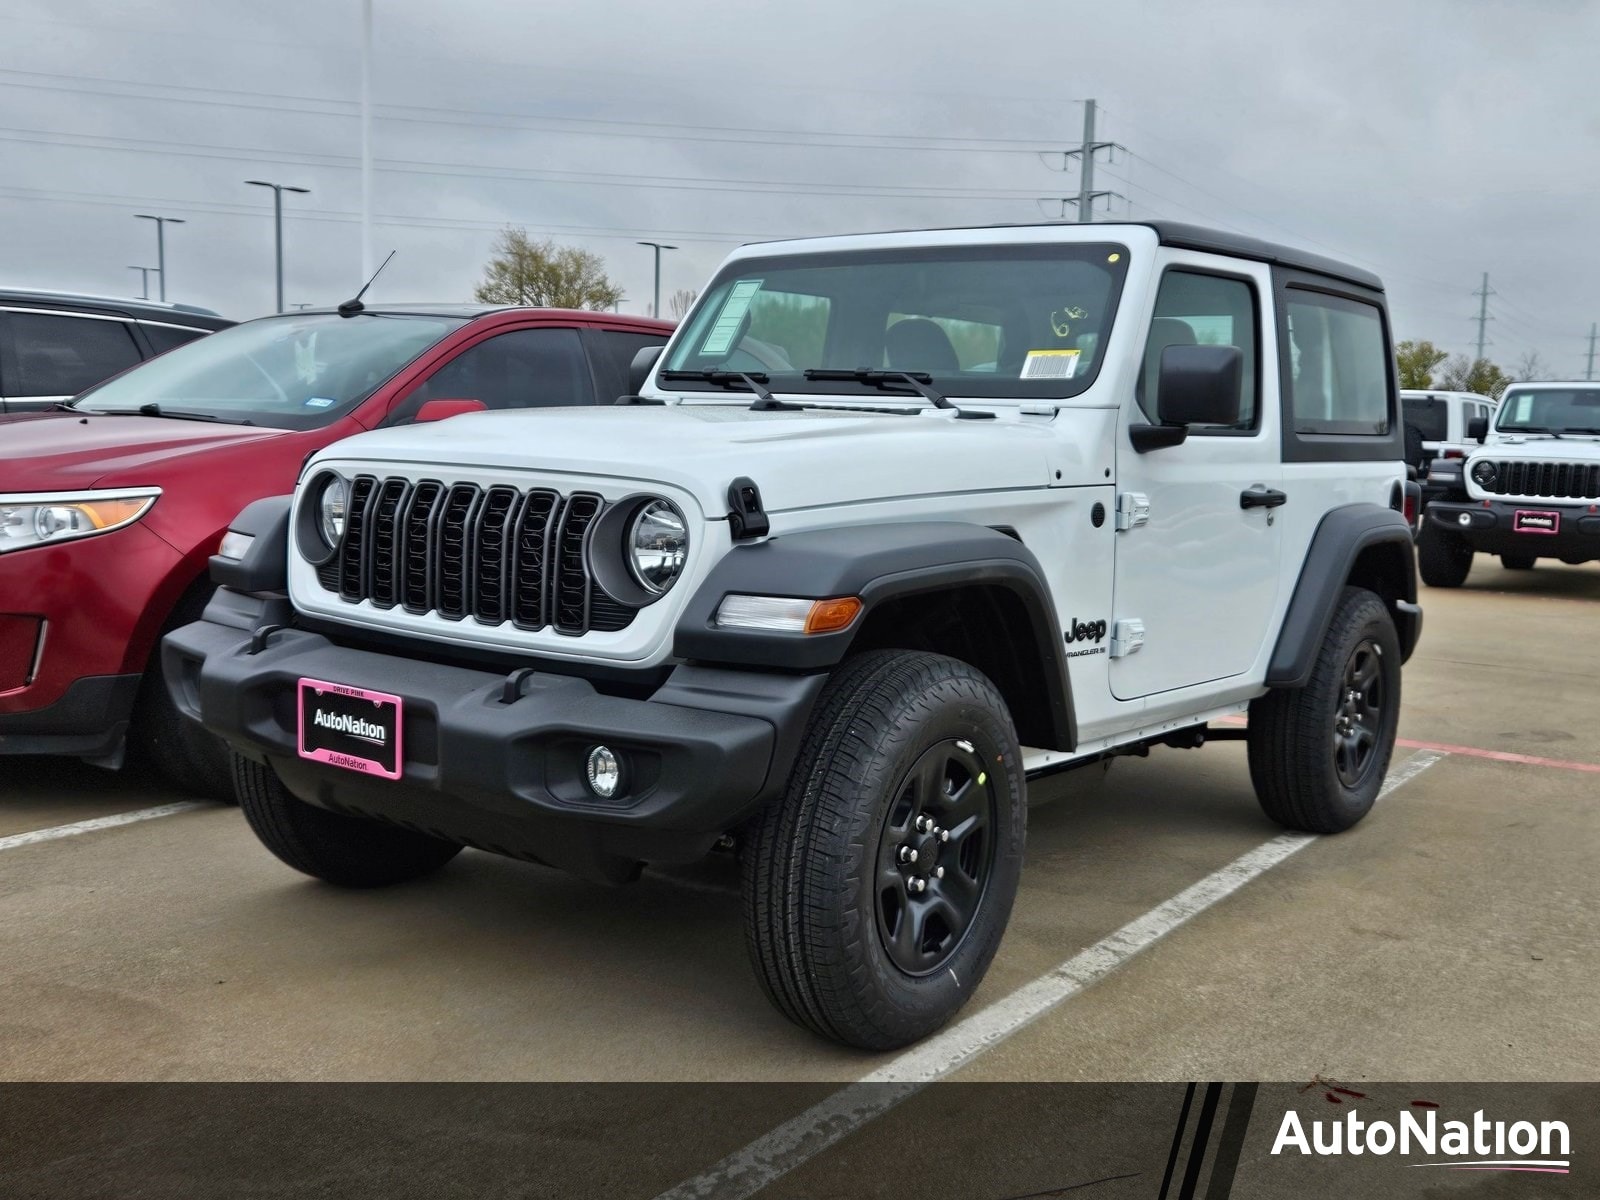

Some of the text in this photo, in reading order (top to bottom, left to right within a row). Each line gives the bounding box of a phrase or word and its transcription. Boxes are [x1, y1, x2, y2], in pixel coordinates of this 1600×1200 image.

[1064, 617, 1107, 644] Jeep
[333, 686, 350, 695] DRIVE
[314, 708, 385, 740] AutoNation
[328, 754, 368, 770] AutoNation
